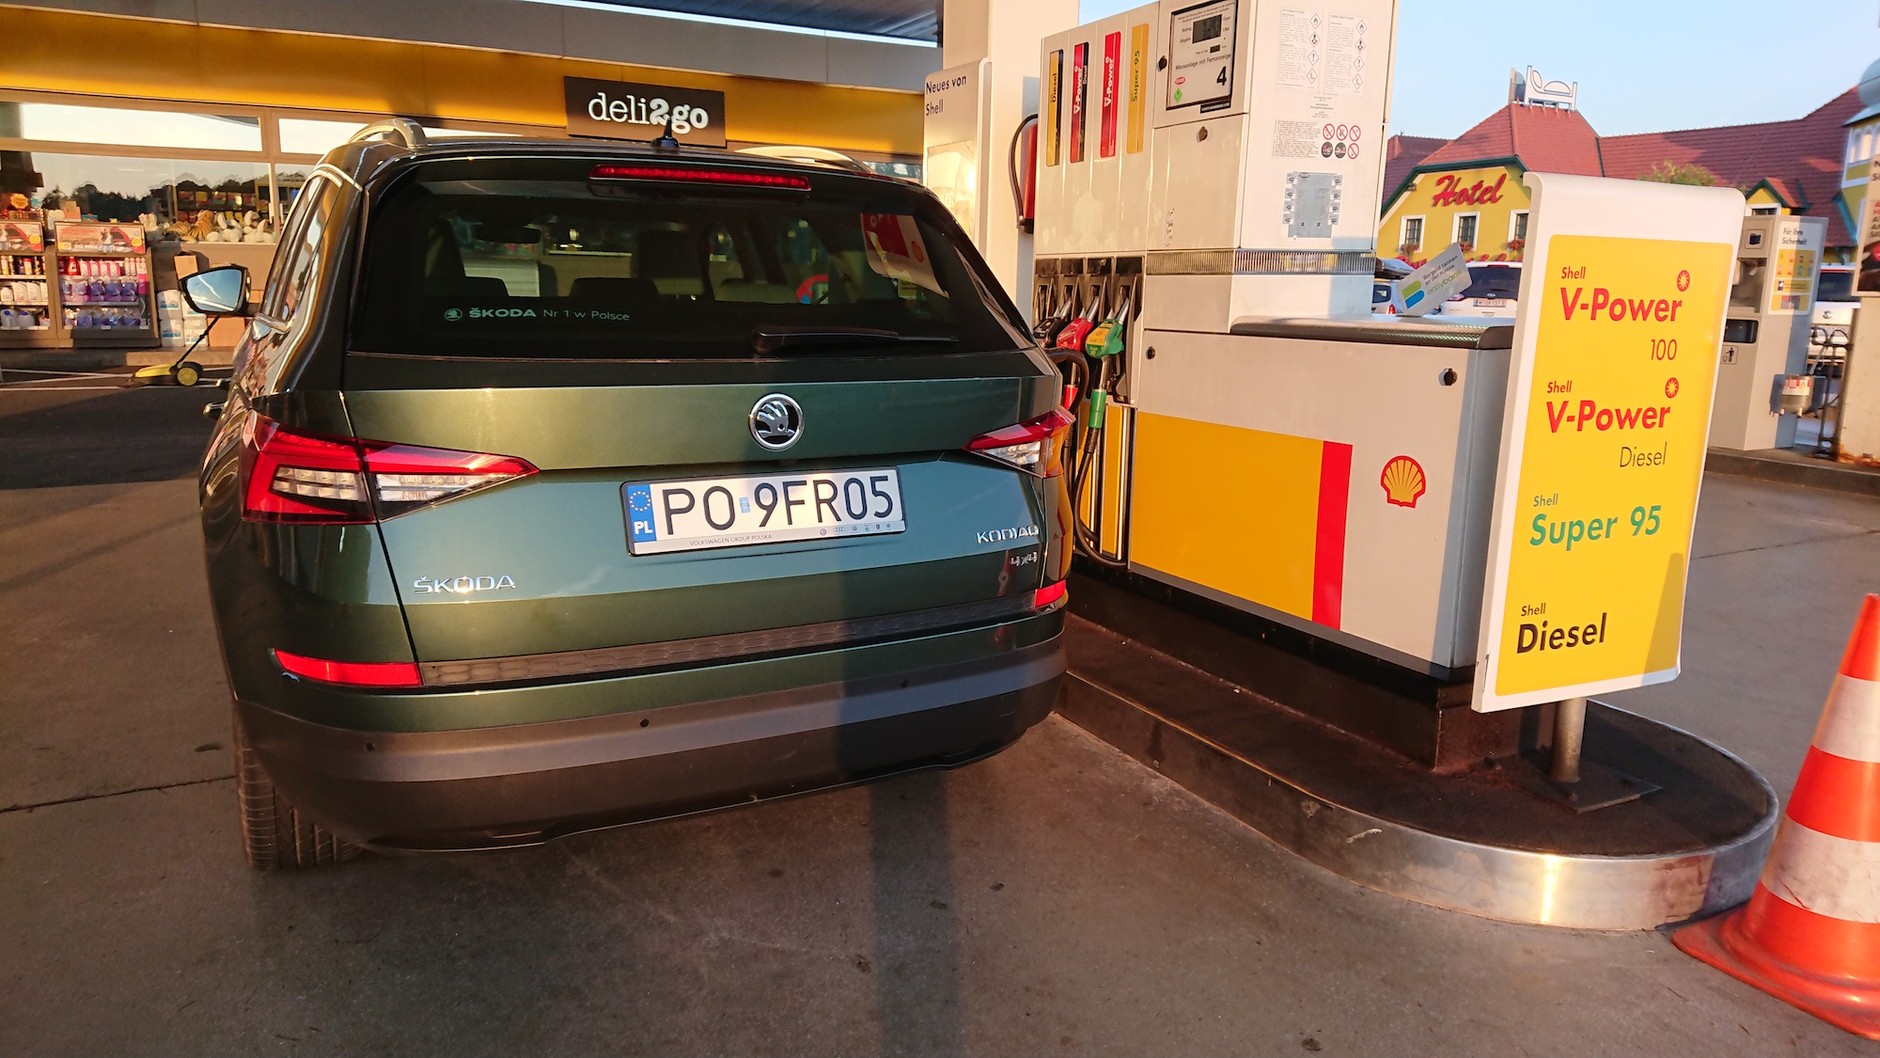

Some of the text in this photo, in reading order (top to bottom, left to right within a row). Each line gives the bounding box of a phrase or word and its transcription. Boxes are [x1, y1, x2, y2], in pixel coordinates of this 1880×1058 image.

[1134, 50, 1139, 65] 95
[926, 76, 966, 95] Neues von
[1104, 58, 1114, 107] V-Power
[1217, 66, 1227, 86] 4
[1074, 66, 1082, 114] V-Power
[588, 92, 709, 134] deli2go
[926, 99, 943, 116] Shell
[1432, 173, 1507, 208] Hotel
[1428, 270, 1462, 295] easybank
[1561, 266, 1586, 279] Shell
[468, 307, 537, 318] ŠKODA
[543, 309, 559, 318] Nr
[564, 310, 569, 318] 1
[592, 310, 630, 321] Polsce
[1560, 287, 1683, 322] V-Power
[1650, 339, 1677, 360] 100
[1547, 380, 1572, 393] Shell
[1546, 400, 1671, 434] V-Power
[1619, 441, 1667, 468] Diesel
[662, 476, 894, 535] PO 9FR05
[1533, 493, 1558, 507] Shell
[634, 520, 653, 535] PL
[1530, 505, 1662, 551] Super 95
[689, 538, 730, 546] VOLKSWAGEN
[1010, 552, 1038, 566] 4x4
[413, 576, 517, 594] ŠKODA
[1521, 603, 1546, 617] Shell
[1516, 612, 1607, 654] Diesel
